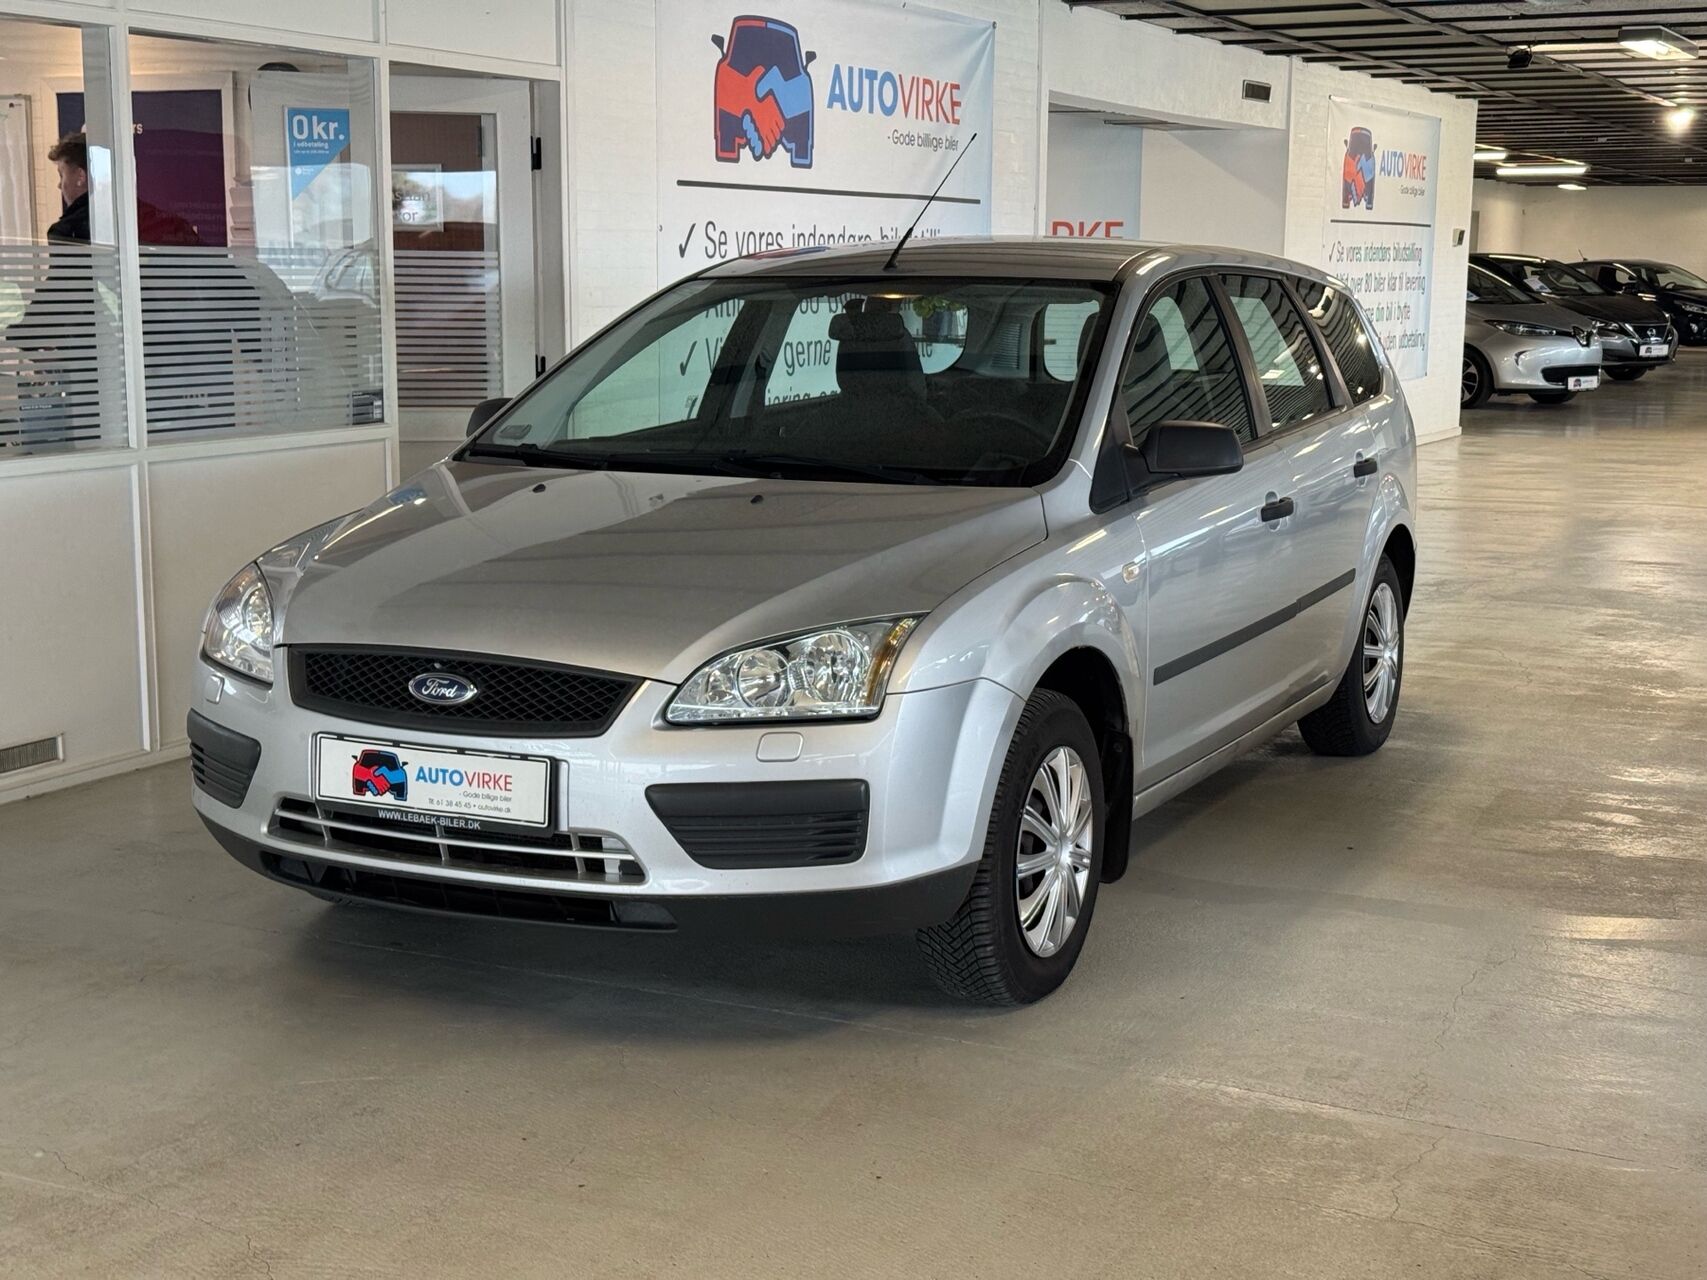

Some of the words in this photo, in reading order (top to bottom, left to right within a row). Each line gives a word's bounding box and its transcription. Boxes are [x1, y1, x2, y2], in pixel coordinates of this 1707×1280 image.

[827, 63, 961, 125] AUTOVIRKE
[292, 114, 309, 140] 0
[312, 115, 345, 140] kr.
[892, 129, 916, 147] Gode
[917, 131, 943, 152] billige
[945, 135, 959, 151] biler
[1379, 150, 1426, 181] AUTOVIRKE
[704, 220, 727, 259] Se
[735, 229, 784, 258] vores
[1336, 240, 1344, 262] Se
[1346, 245, 1362, 262] vores
[1364, 272, 1373, 293] 80
[1374, 272, 1386, 292] biler
[1387, 271, 1398, 292] klar
[1405, 271, 1426, 295] levering
[1376, 301, 1385, 322] din
[1386, 301, 1394, 322] bil
[783, 338, 832, 377] gerne
[421, 677, 458, 698] Ford
[415, 765, 513, 792] AUTOVIRKE
[455, 800, 462, 808] 45
[463, 801, 472, 809] 45
[463, 791, 481, 799] Gode
[377, 808, 481, 830] WWW.LEBAEK-BILER.DK
